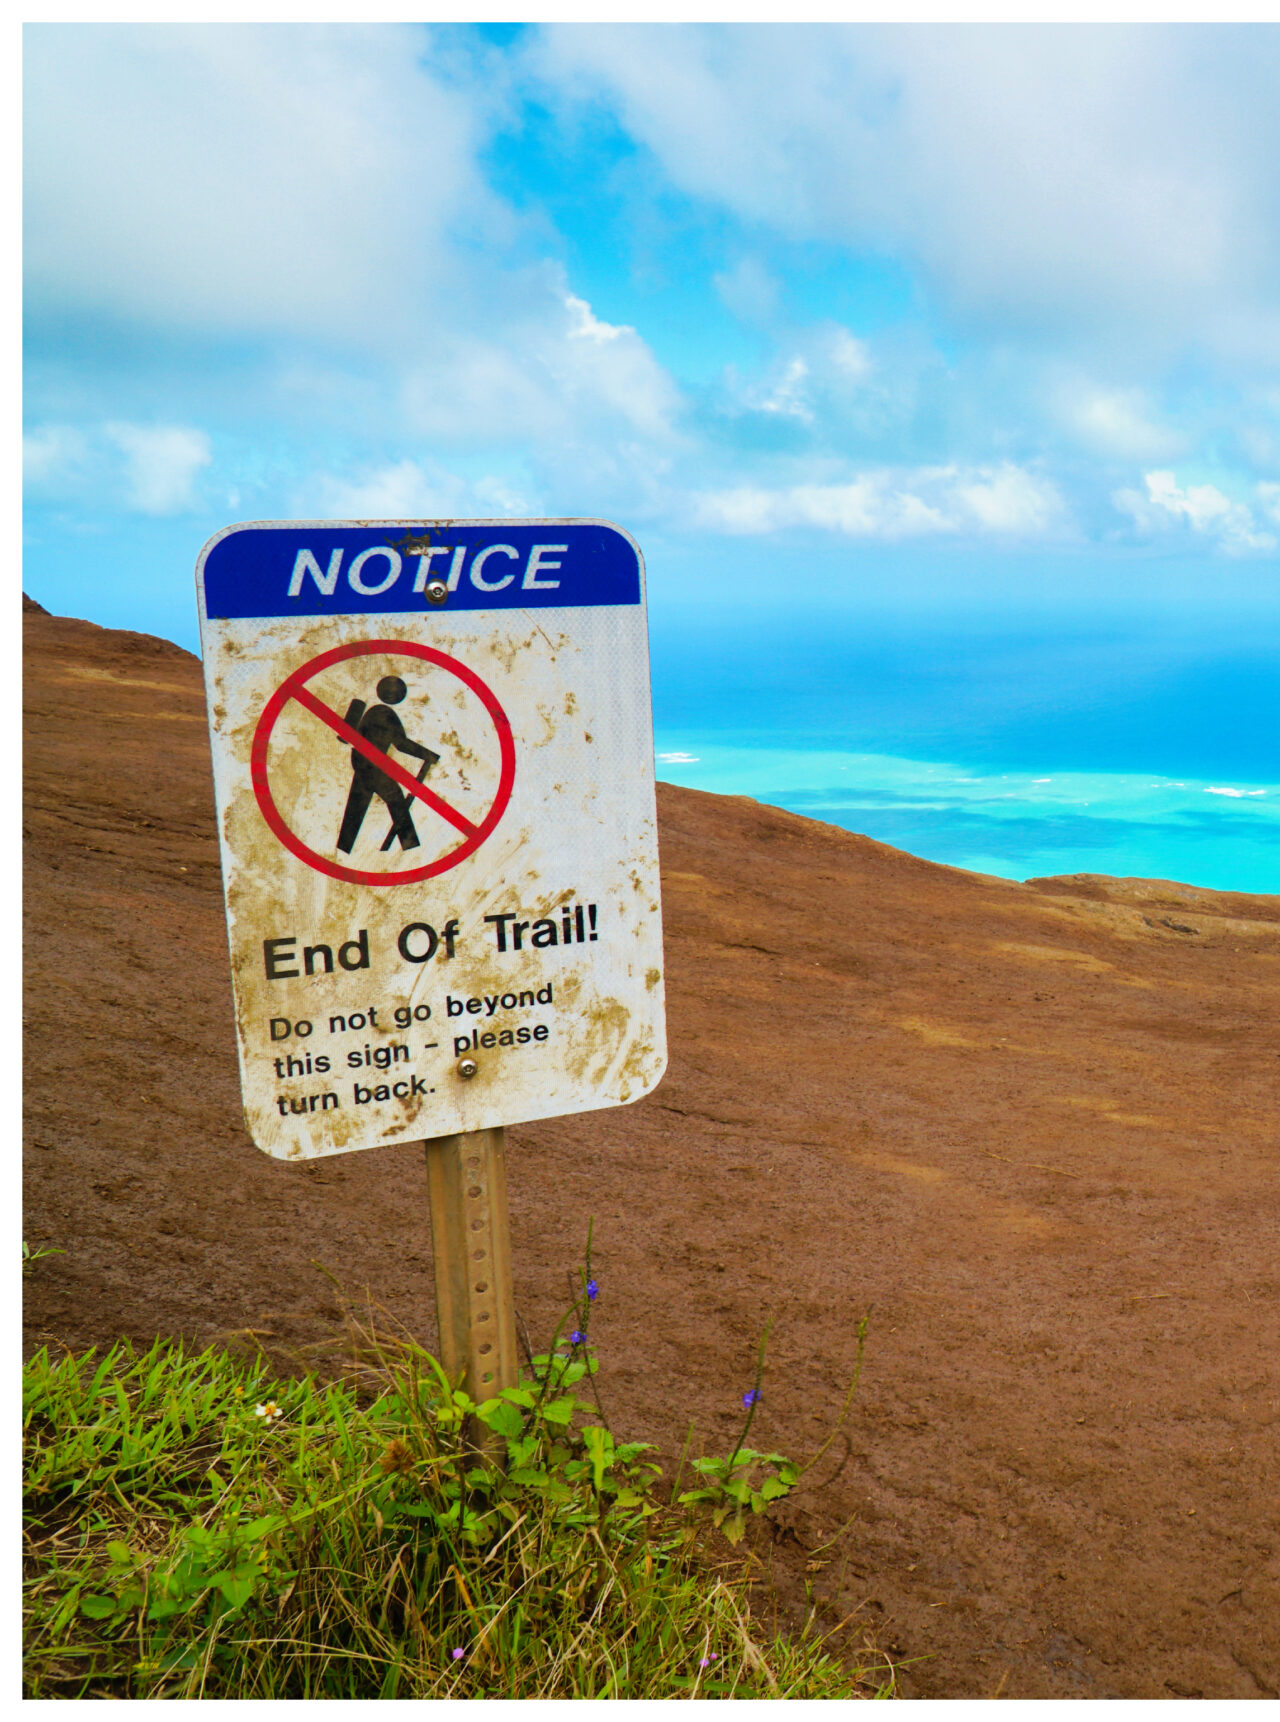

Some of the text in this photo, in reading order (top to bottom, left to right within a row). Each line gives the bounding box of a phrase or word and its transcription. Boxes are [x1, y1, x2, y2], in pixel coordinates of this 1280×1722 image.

[287, 544, 569, 597] NOTICE
[263, 904, 599, 980] End Of Trail!
[270, 983, 553, 1041] Do not go beyond
[273, 1052, 331, 1079] this
[347, 1042, 409, 1070] sign
[454, 1024, 549, 1058] please
[277, 1073, 435, 1116] turn back.
